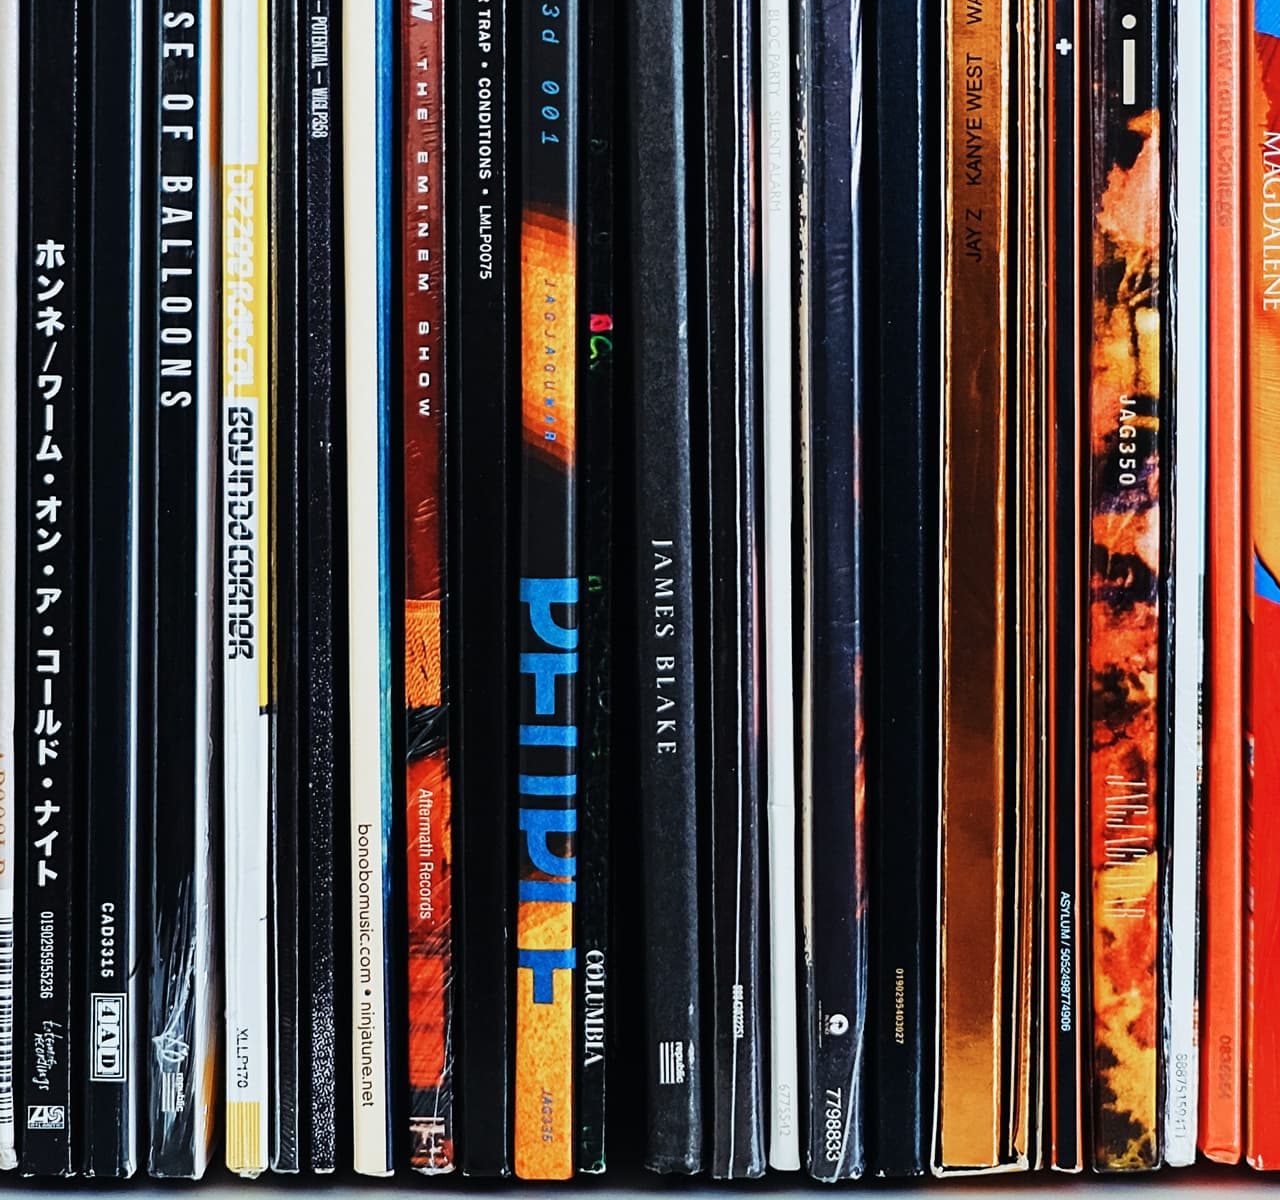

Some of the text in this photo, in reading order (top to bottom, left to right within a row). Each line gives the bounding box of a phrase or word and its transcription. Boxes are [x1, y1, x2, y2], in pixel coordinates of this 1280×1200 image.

[312, 17, 328, 68] POTENTIAL
[478, 9, 491, 52] TRAP
[162, 94, 193, 138] OF
[312, 88, 328, 138] WIGLP358
[478, 78, 491, 179] CONDITIONS
[479, 205, 492, 279] LMLP0075
[161, 176, 193, 407] BALLOONS
[1120, 394, 1137, 484] JAG350
[652, 540, 676, 753] JAMES BLAKE
[419, 789, 434, 919] Aftermath Records
[40, 912, 54, 998] 0190295955236
[101, 903, 114, 977] CAD3315
[358, 824, 374, 1106] bonobomusic.com ninjatune.net
[586, 950, 604, 1066] COLUMBIA
[826, 1088, 841, 1161] 7798833
